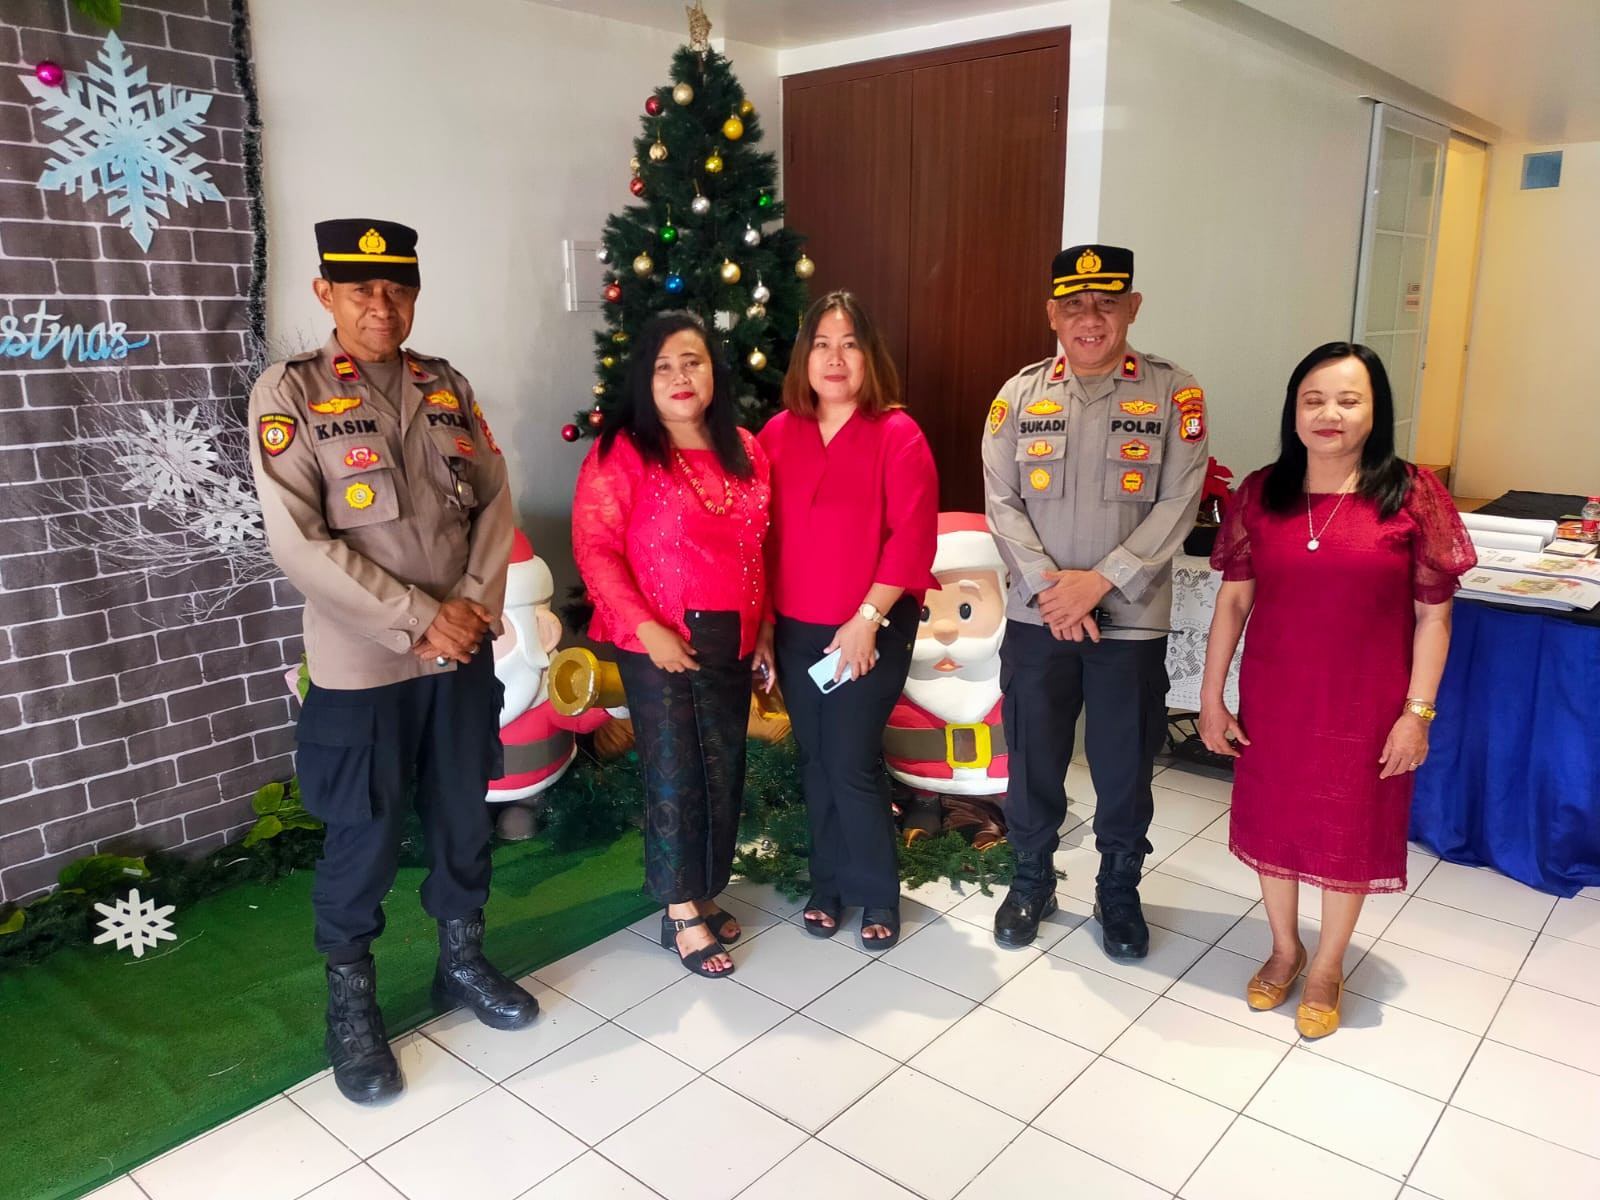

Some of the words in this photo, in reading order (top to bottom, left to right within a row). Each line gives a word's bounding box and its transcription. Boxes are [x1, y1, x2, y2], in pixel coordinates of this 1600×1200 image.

[314, 418, 379, 441] KASIM
[426, 412, 471, 431] POL
[1020, 419, 1066, 434] SUKADI
[1111, 419, 1162, 435] POLRI
